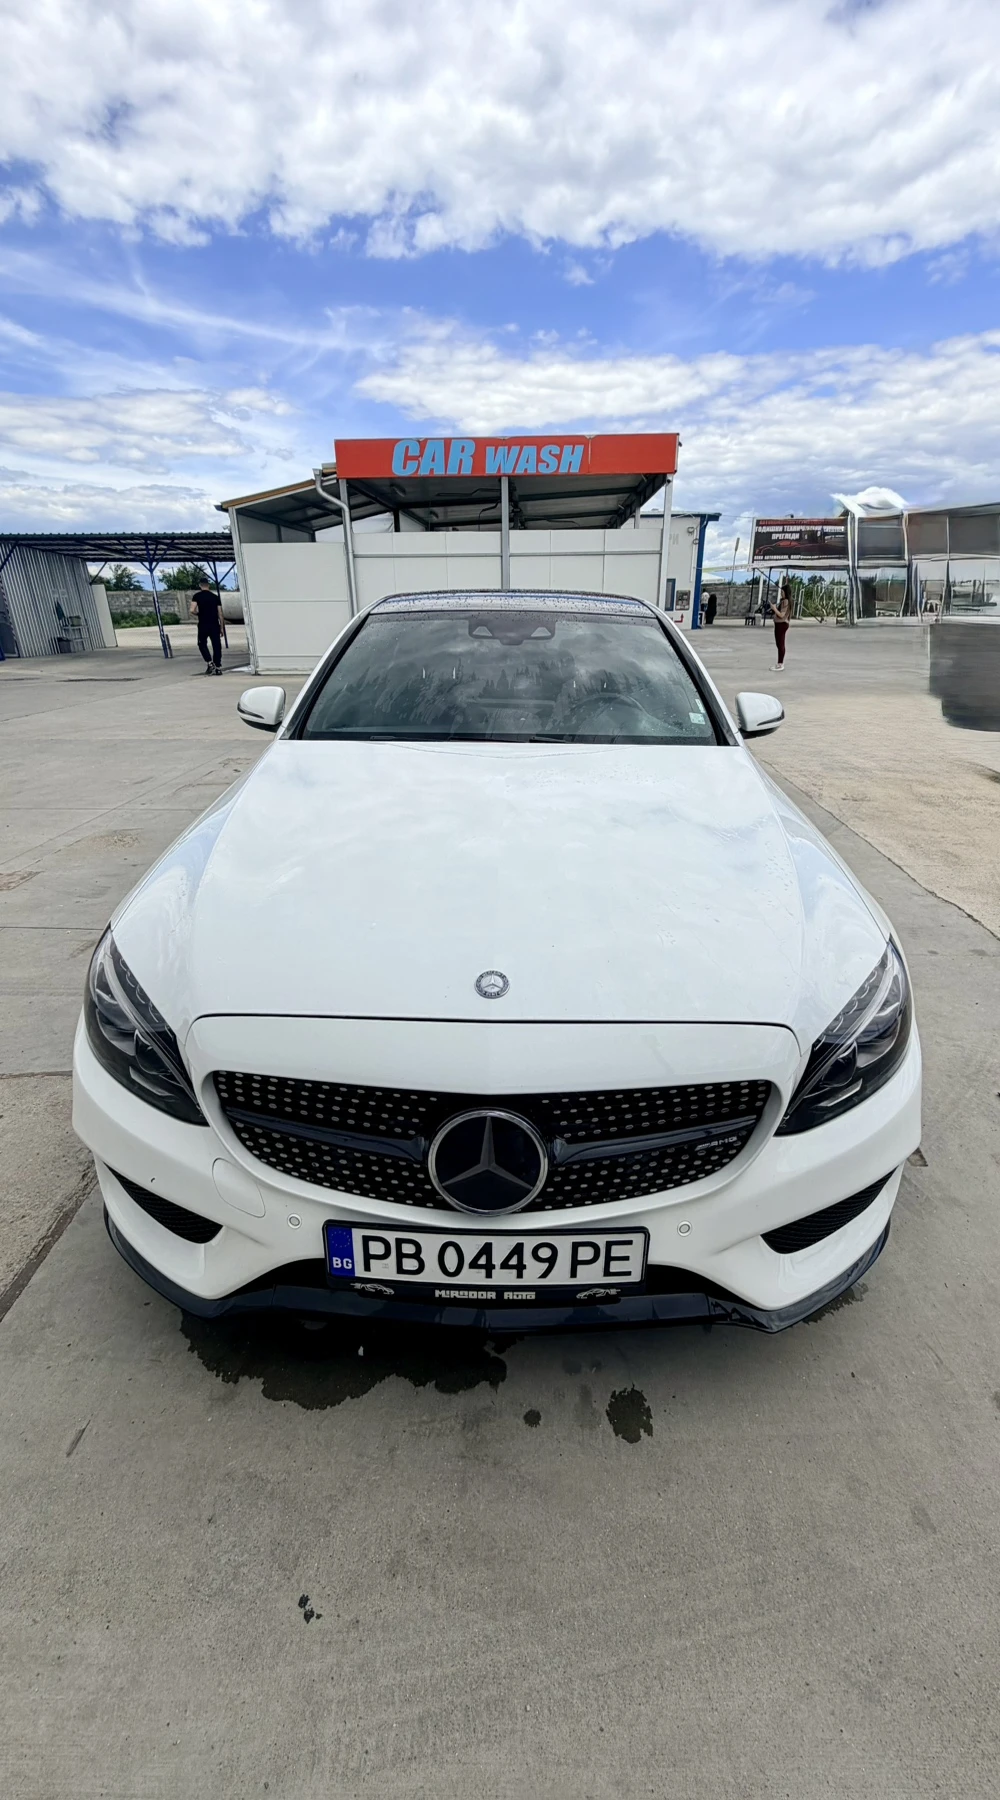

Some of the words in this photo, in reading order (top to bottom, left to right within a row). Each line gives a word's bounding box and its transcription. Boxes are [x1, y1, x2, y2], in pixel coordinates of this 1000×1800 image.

[392, 439, 476, 476] CAR
[485, 444, 585, 475] WASH
[332, 1256, 353, 1270] BG
[362, 1234, 425, 1275] PB
[437, 1240, 559, 1279] 0449
[569, 1239, 634, 1279] PE
